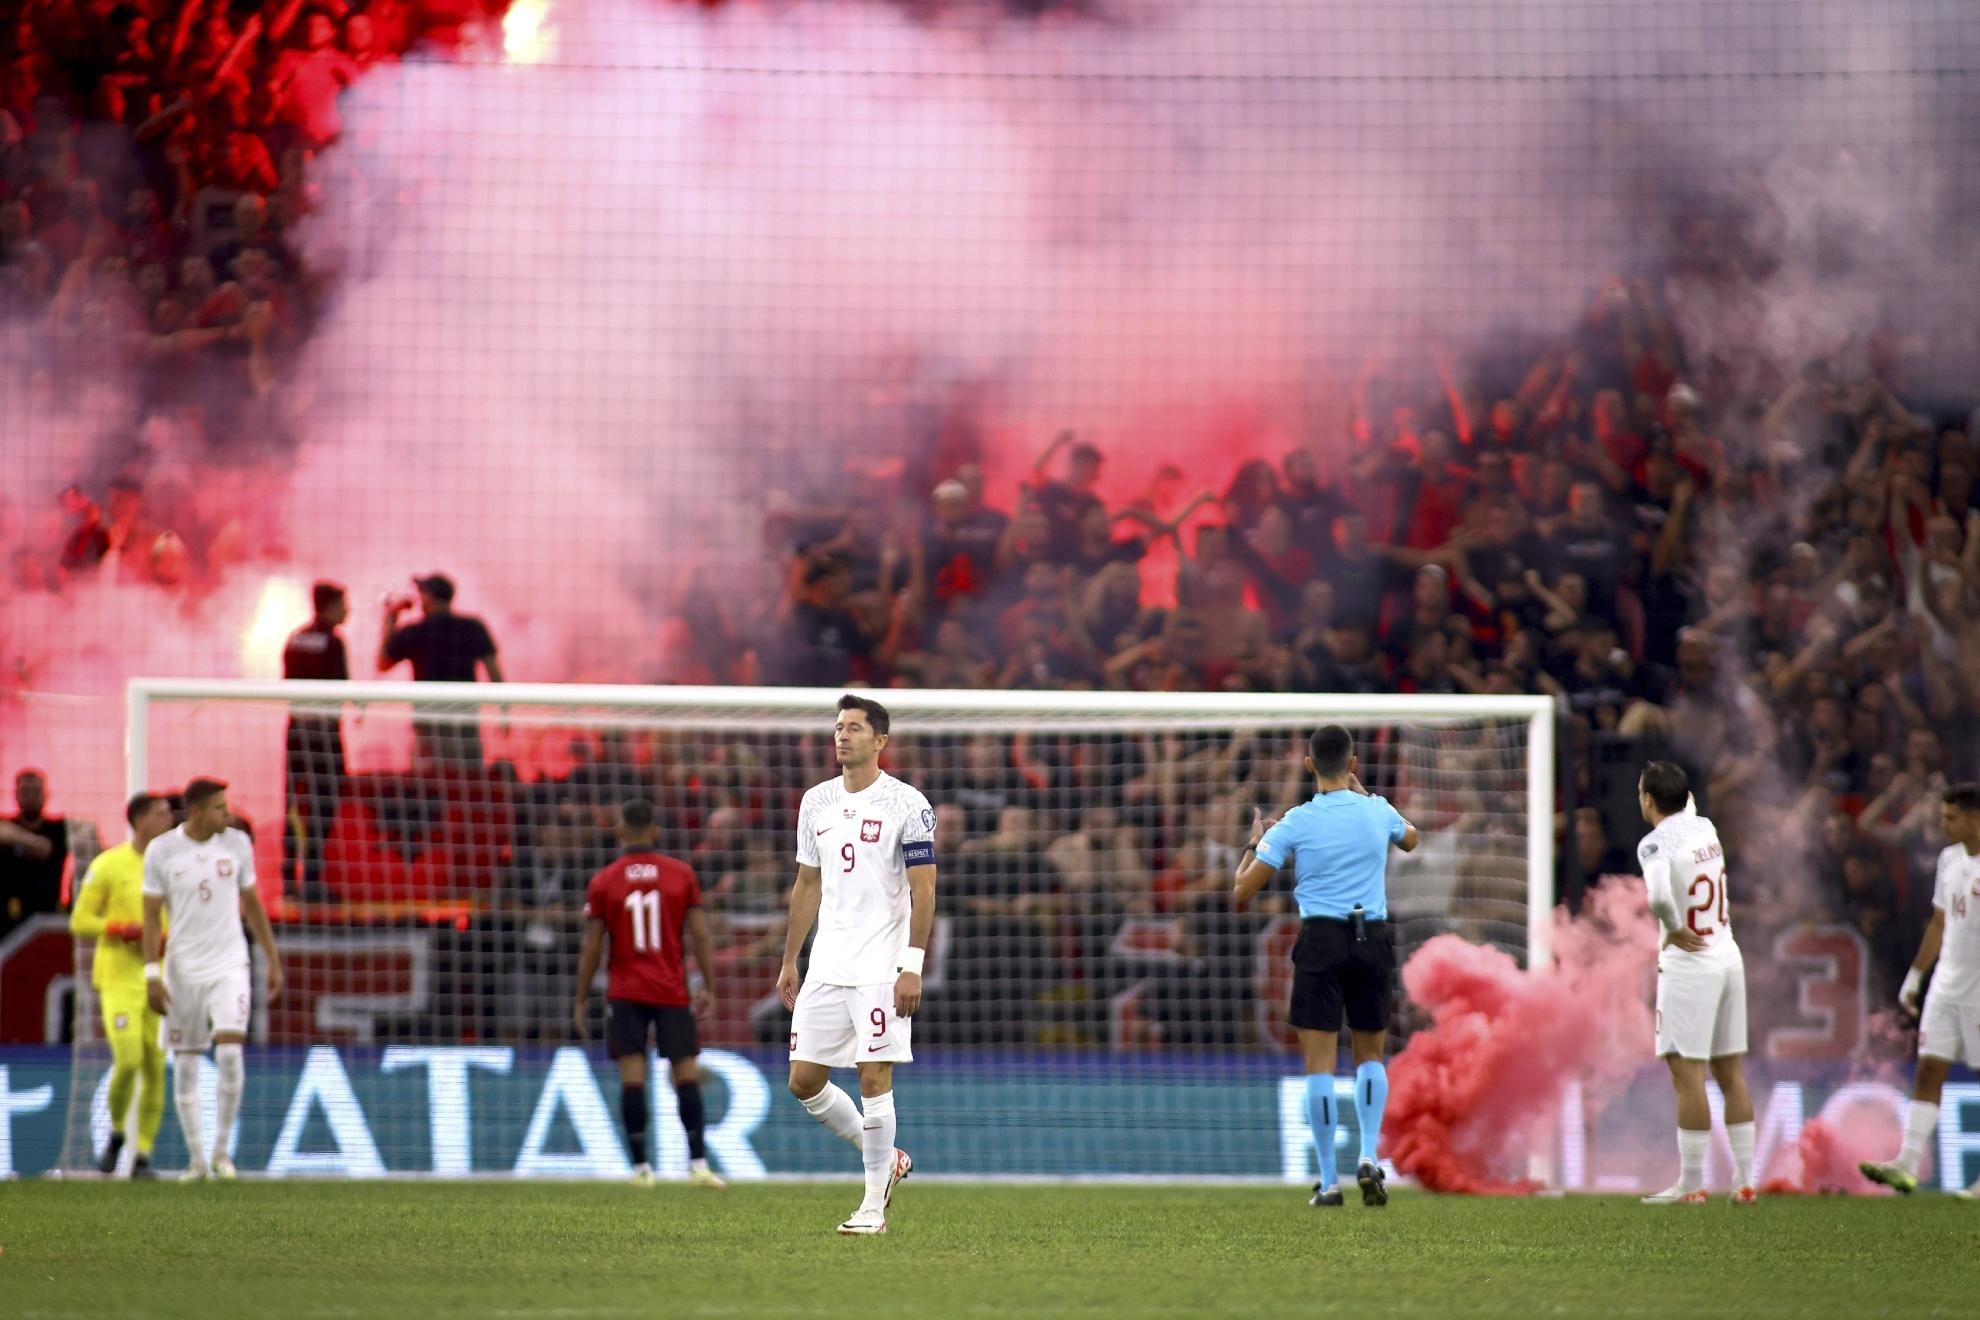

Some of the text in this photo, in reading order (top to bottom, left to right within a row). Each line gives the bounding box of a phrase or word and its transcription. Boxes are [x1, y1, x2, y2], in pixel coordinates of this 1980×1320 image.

[841, 843, 855, 872] 9
[198, 879, 212, 902] 5
[624, 889, 661, 952] 11
[1951, 893, 1967, 919] 14
[870, 1007, 886, 1037] 9
